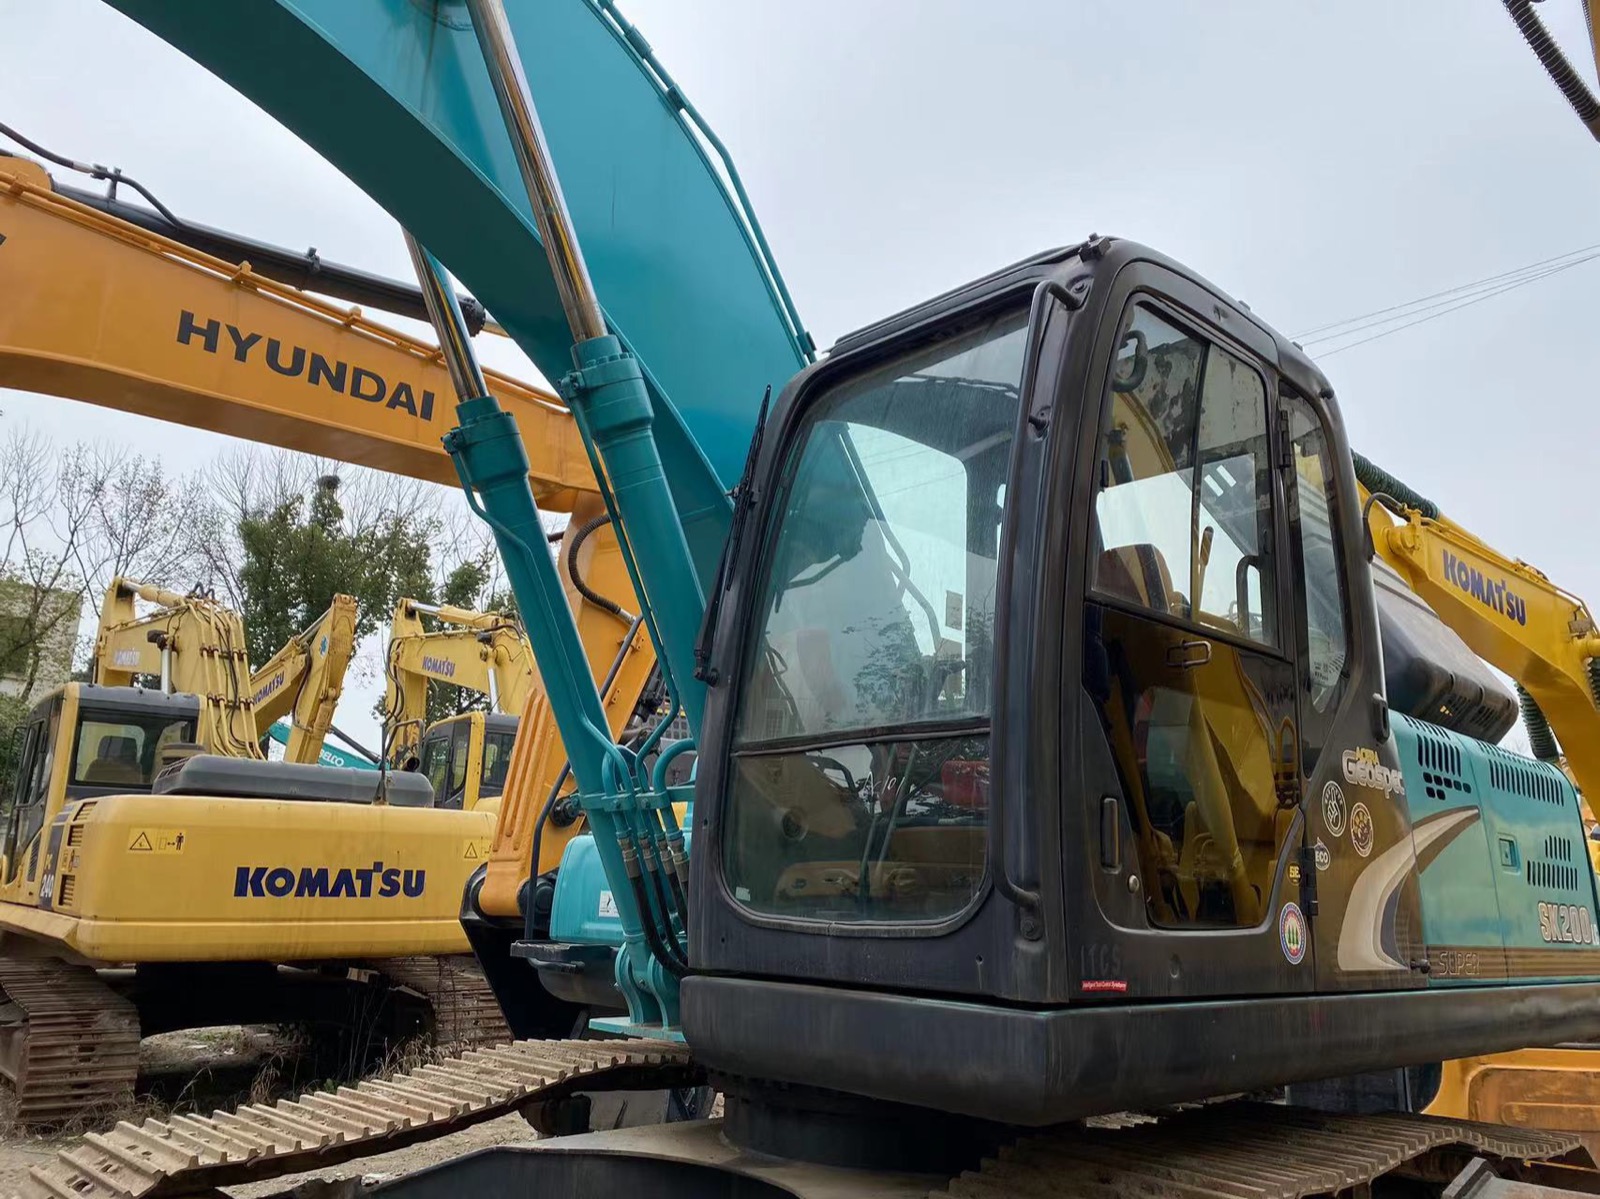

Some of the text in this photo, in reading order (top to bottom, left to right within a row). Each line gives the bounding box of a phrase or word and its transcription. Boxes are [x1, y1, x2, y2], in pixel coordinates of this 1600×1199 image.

[177, 309, 435, 421] HYUNDAI
[1443, 548, 1526, 627] KOMATSU
[422, 656, 456, 677] KOMATSU
[1315, 850, 1328, 863] ECO
[234, 862, 425, 897] KOMATSU
[1538, 901, 1592, 944] SK200
[1439, 950, 1480, 976] SUPER
